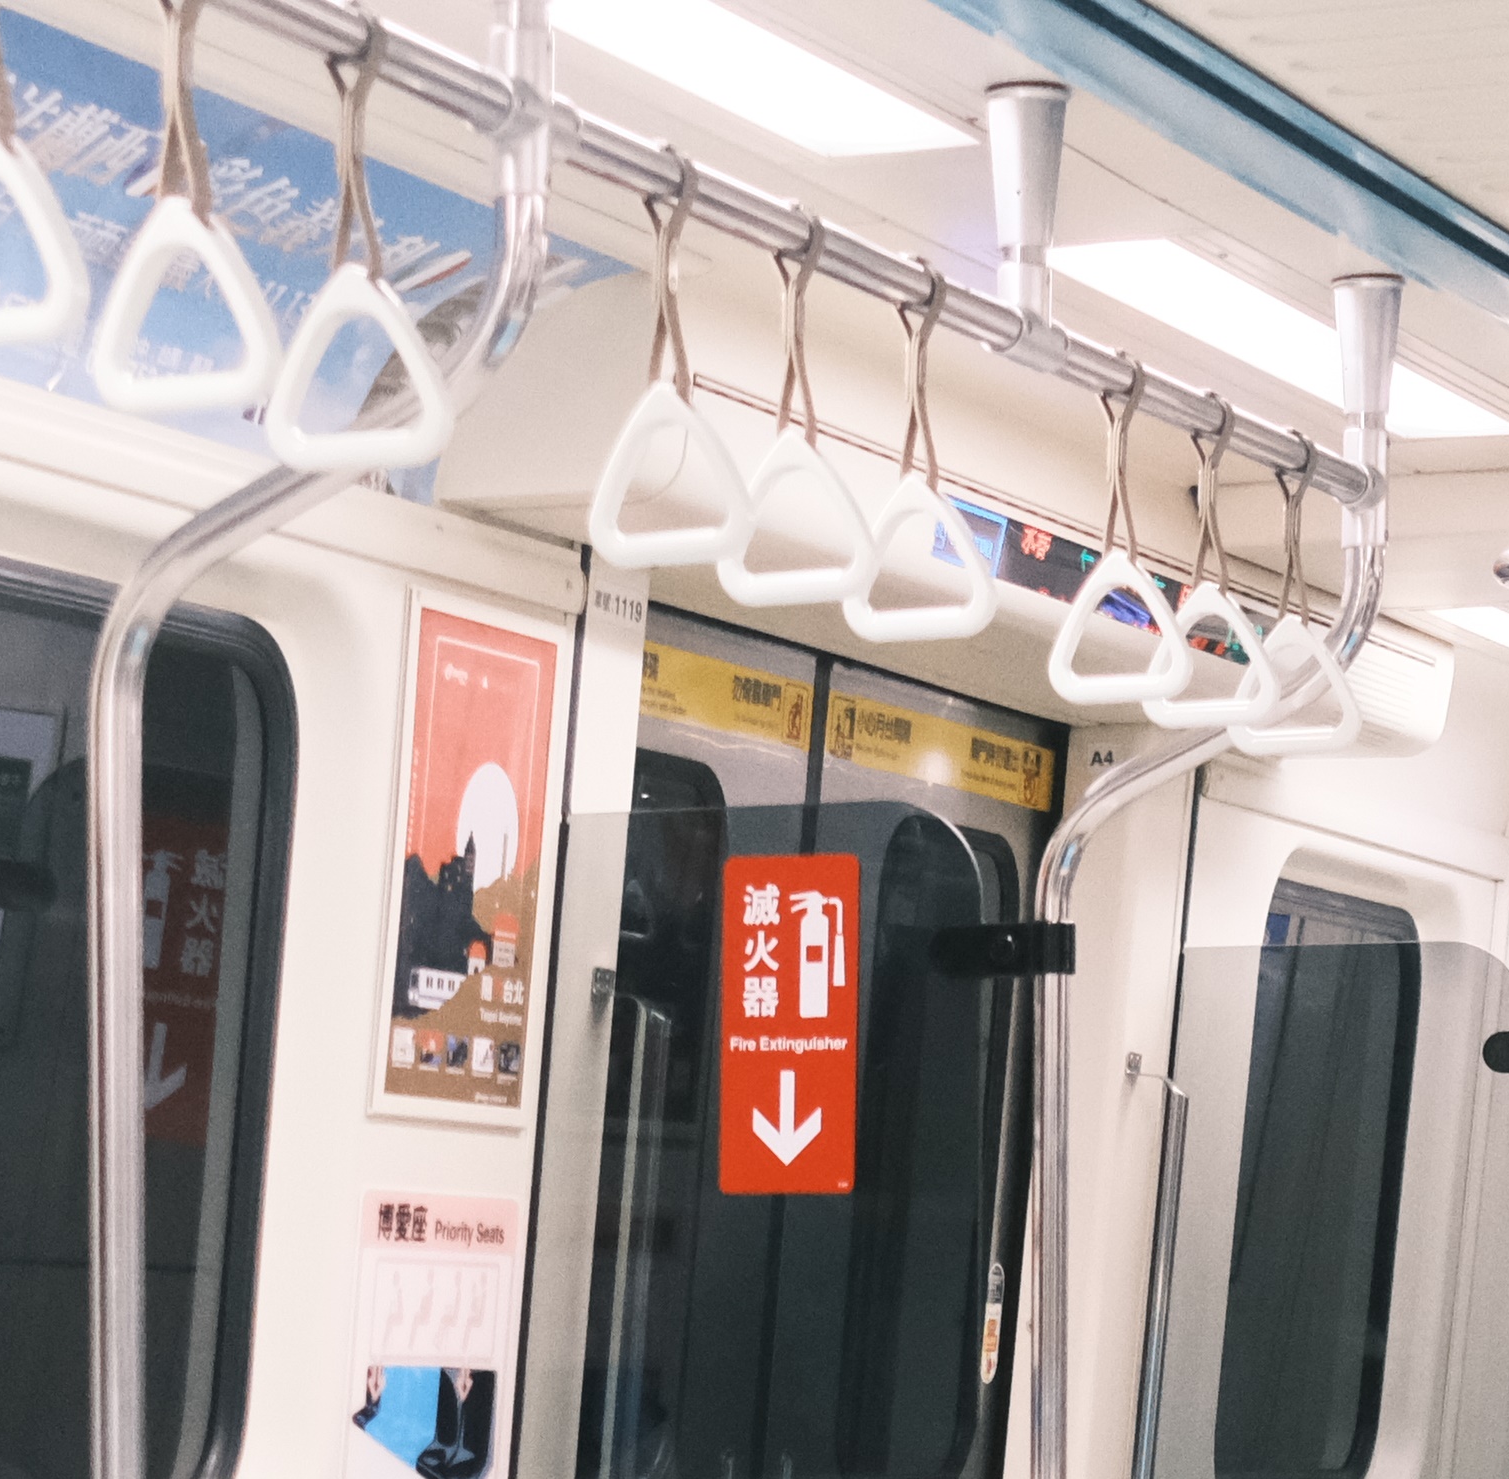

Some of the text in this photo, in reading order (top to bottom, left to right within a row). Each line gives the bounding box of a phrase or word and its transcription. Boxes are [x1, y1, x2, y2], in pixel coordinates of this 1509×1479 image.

[1090, 750, 1115, 767] A4
[743, 882, 781, 1019] 滅火器
[730, 1035, 848, 1055] Fire Extinguisher
[377, 1203, 505, 1248] 博愛座 Priority Seats
